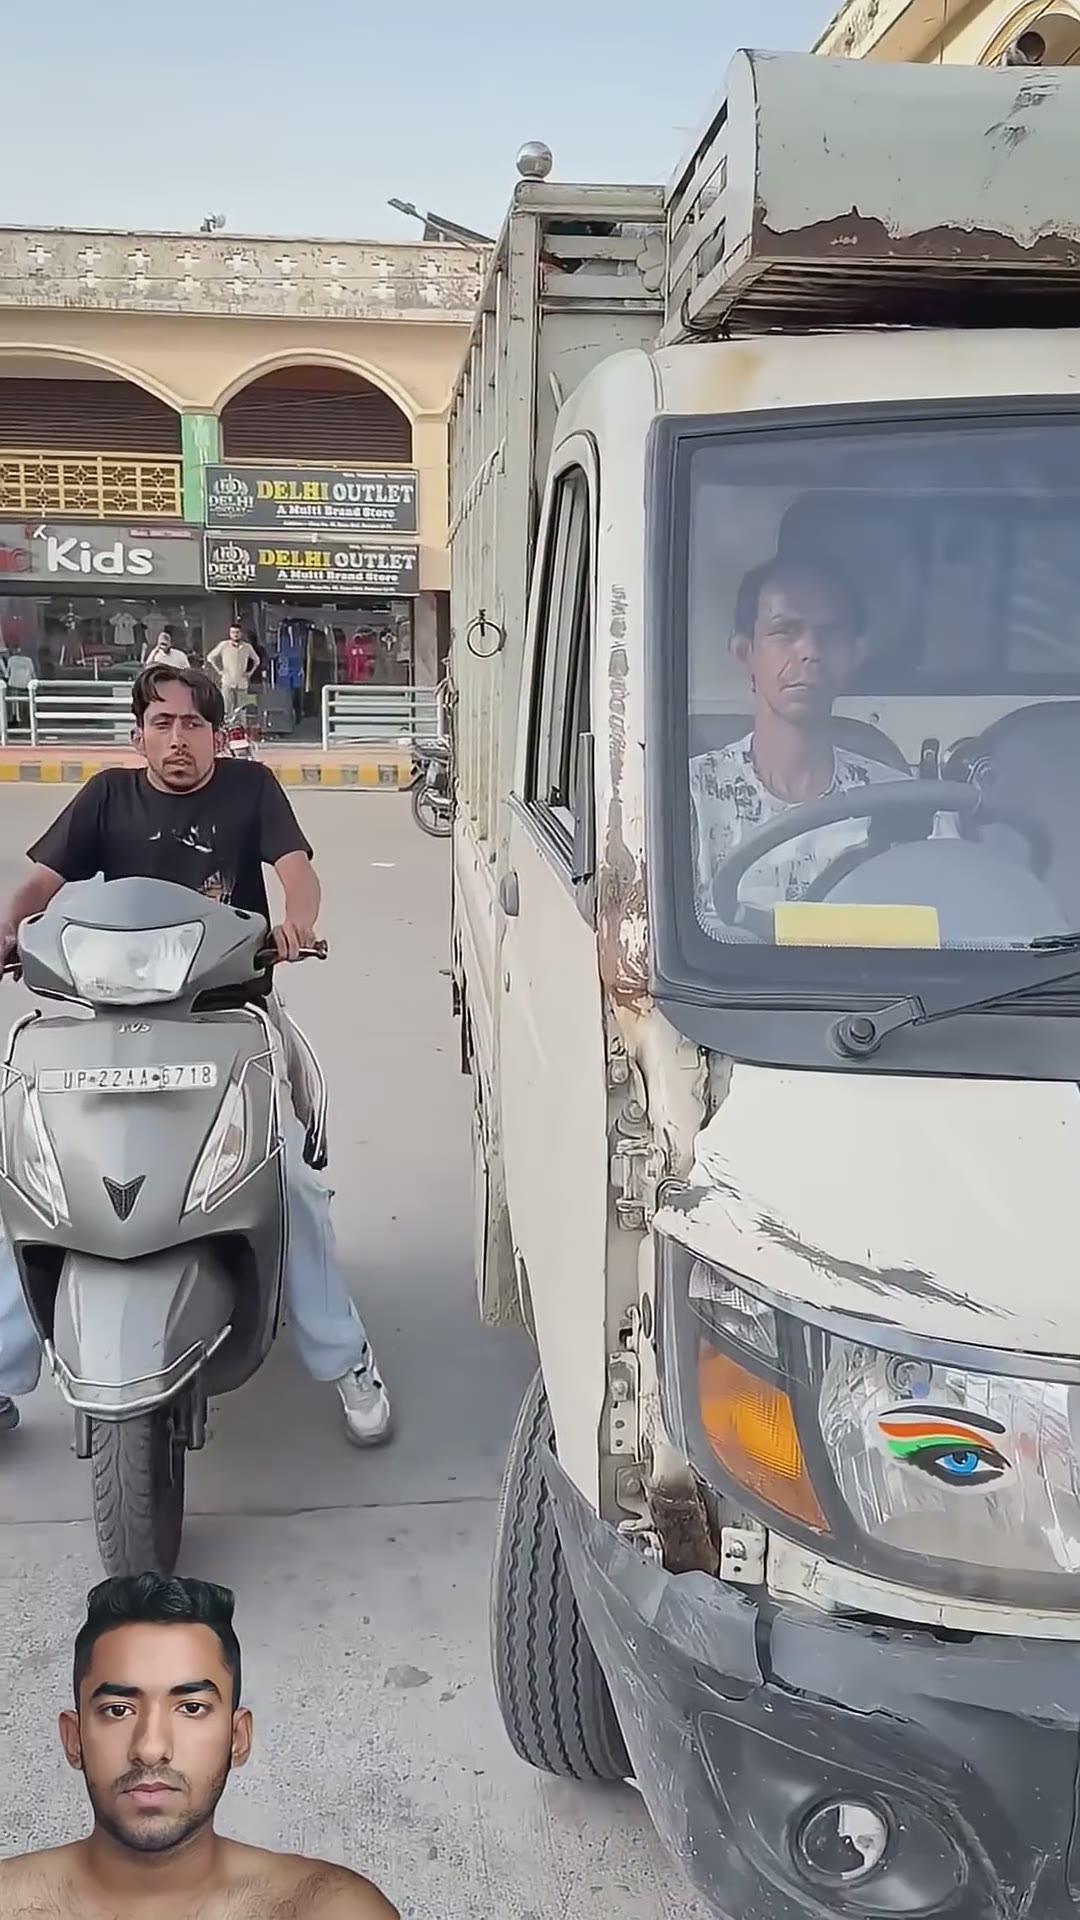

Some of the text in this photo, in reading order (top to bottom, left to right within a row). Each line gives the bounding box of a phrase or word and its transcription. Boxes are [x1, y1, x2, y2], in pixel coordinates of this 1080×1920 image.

[256, 480, 414, 503] DELHI OUTLET
[209, 495, 254, 509] DELHI
[276, 504, 396, 518] A Multi Brand Store
[47, 536, 153, 575] Kids
[258, 548, 331, 567] DELHI
[334, 552, 416, 570] OUTLET
[208, 563, 256, 577] DELHI
[277, 570, 399, 582] A Multi Brand Store
